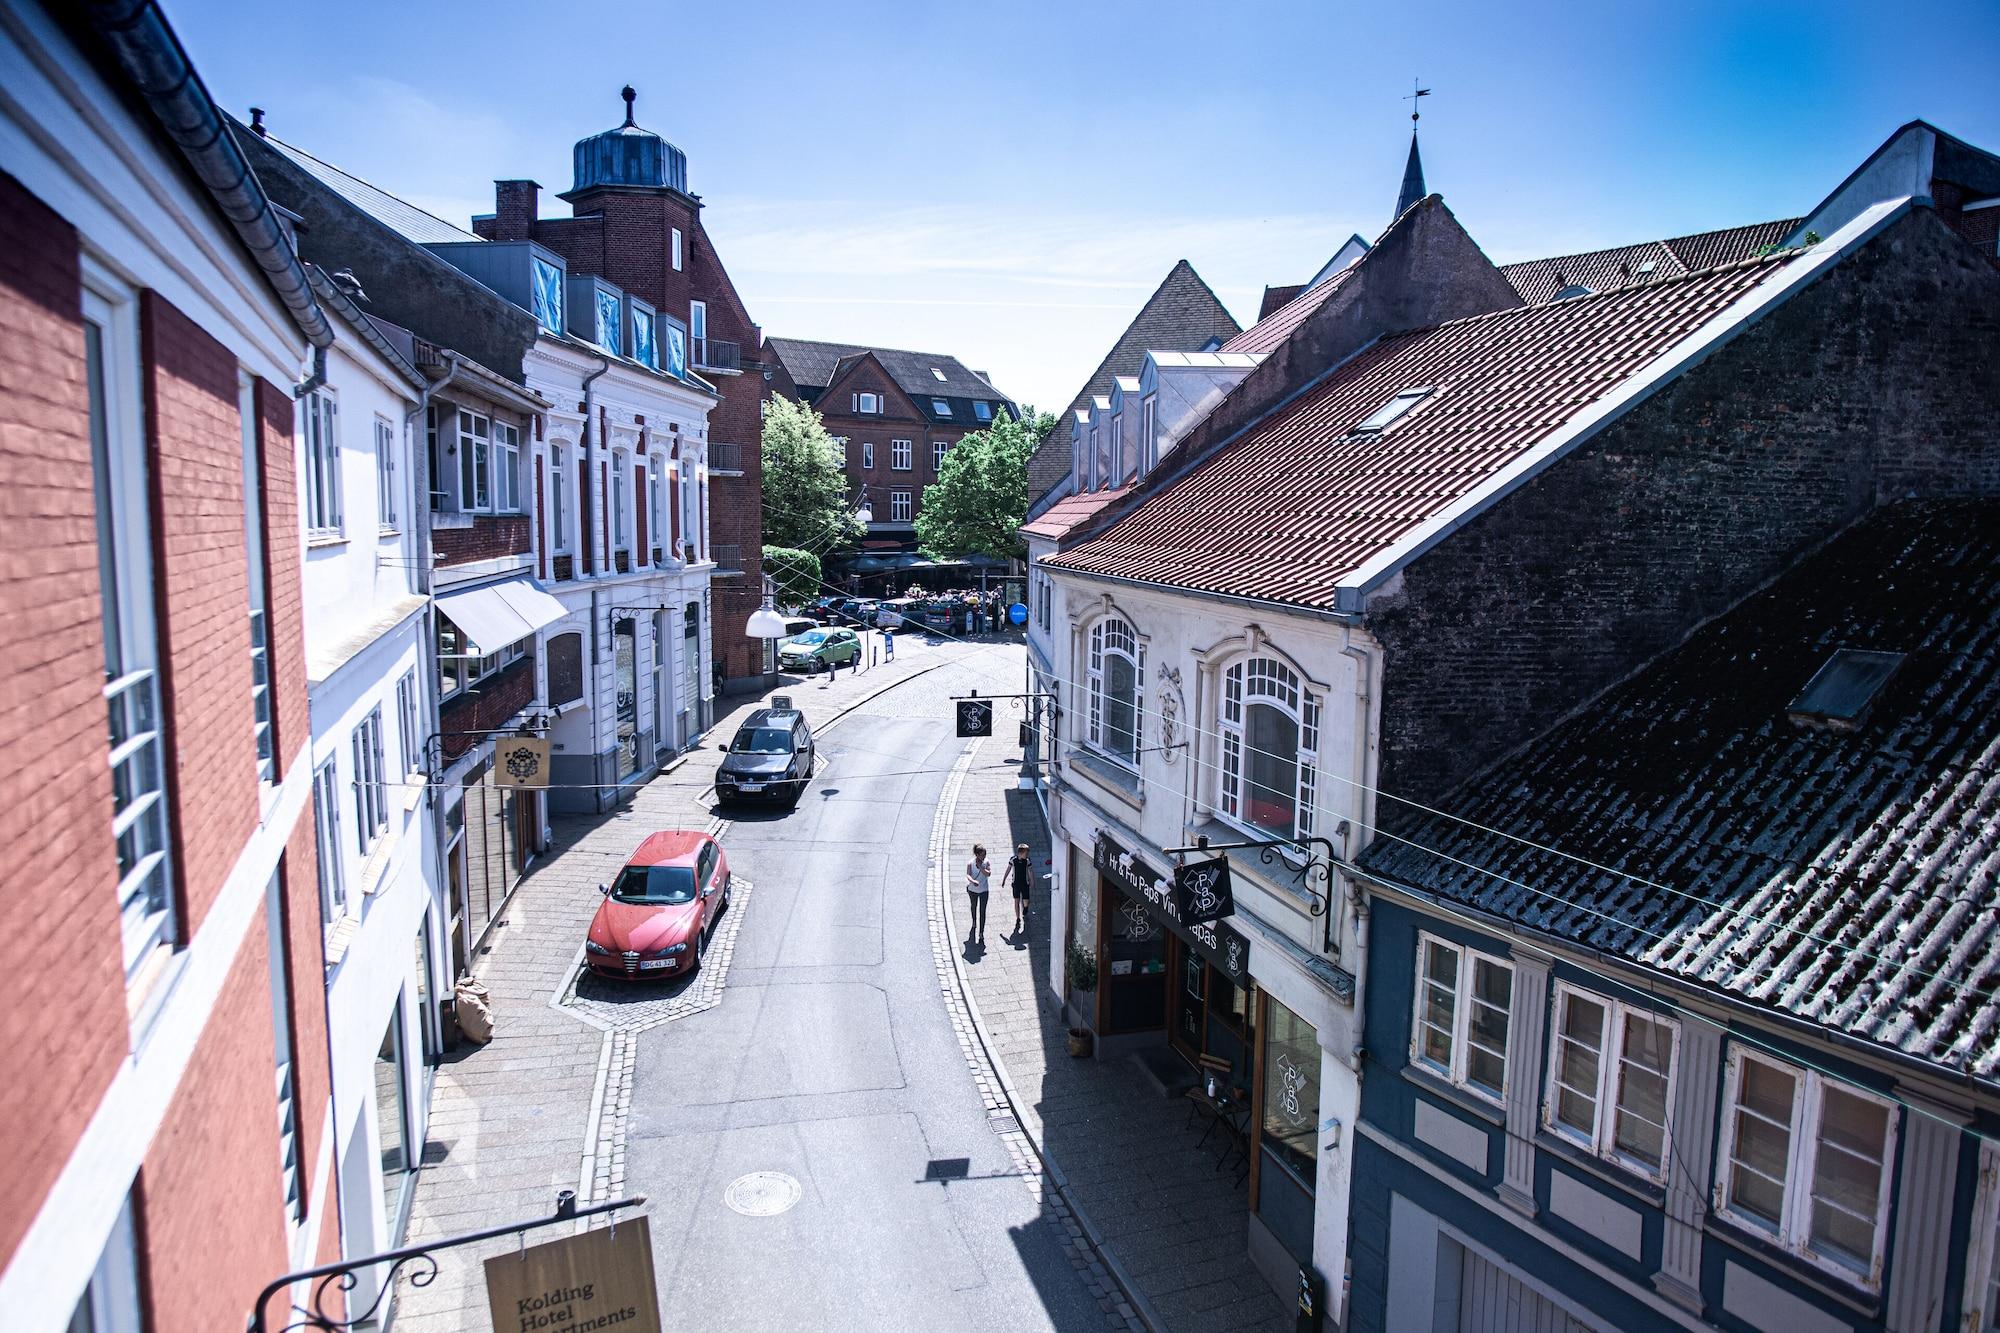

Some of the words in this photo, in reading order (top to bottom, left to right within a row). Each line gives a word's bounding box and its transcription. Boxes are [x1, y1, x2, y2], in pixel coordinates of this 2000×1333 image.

[1109, 853, 1118, 871] Hr
[1125, 866, 1138, 887] Fru
[1139, 875, 1159, 904] Paps
[1162, 895, 1176, 917] Vin
[1189, 924, 1217, 950] apas
[517, 1284, 594, 1315] Kolding
[520, 1305, 574, 1332] Hotel
